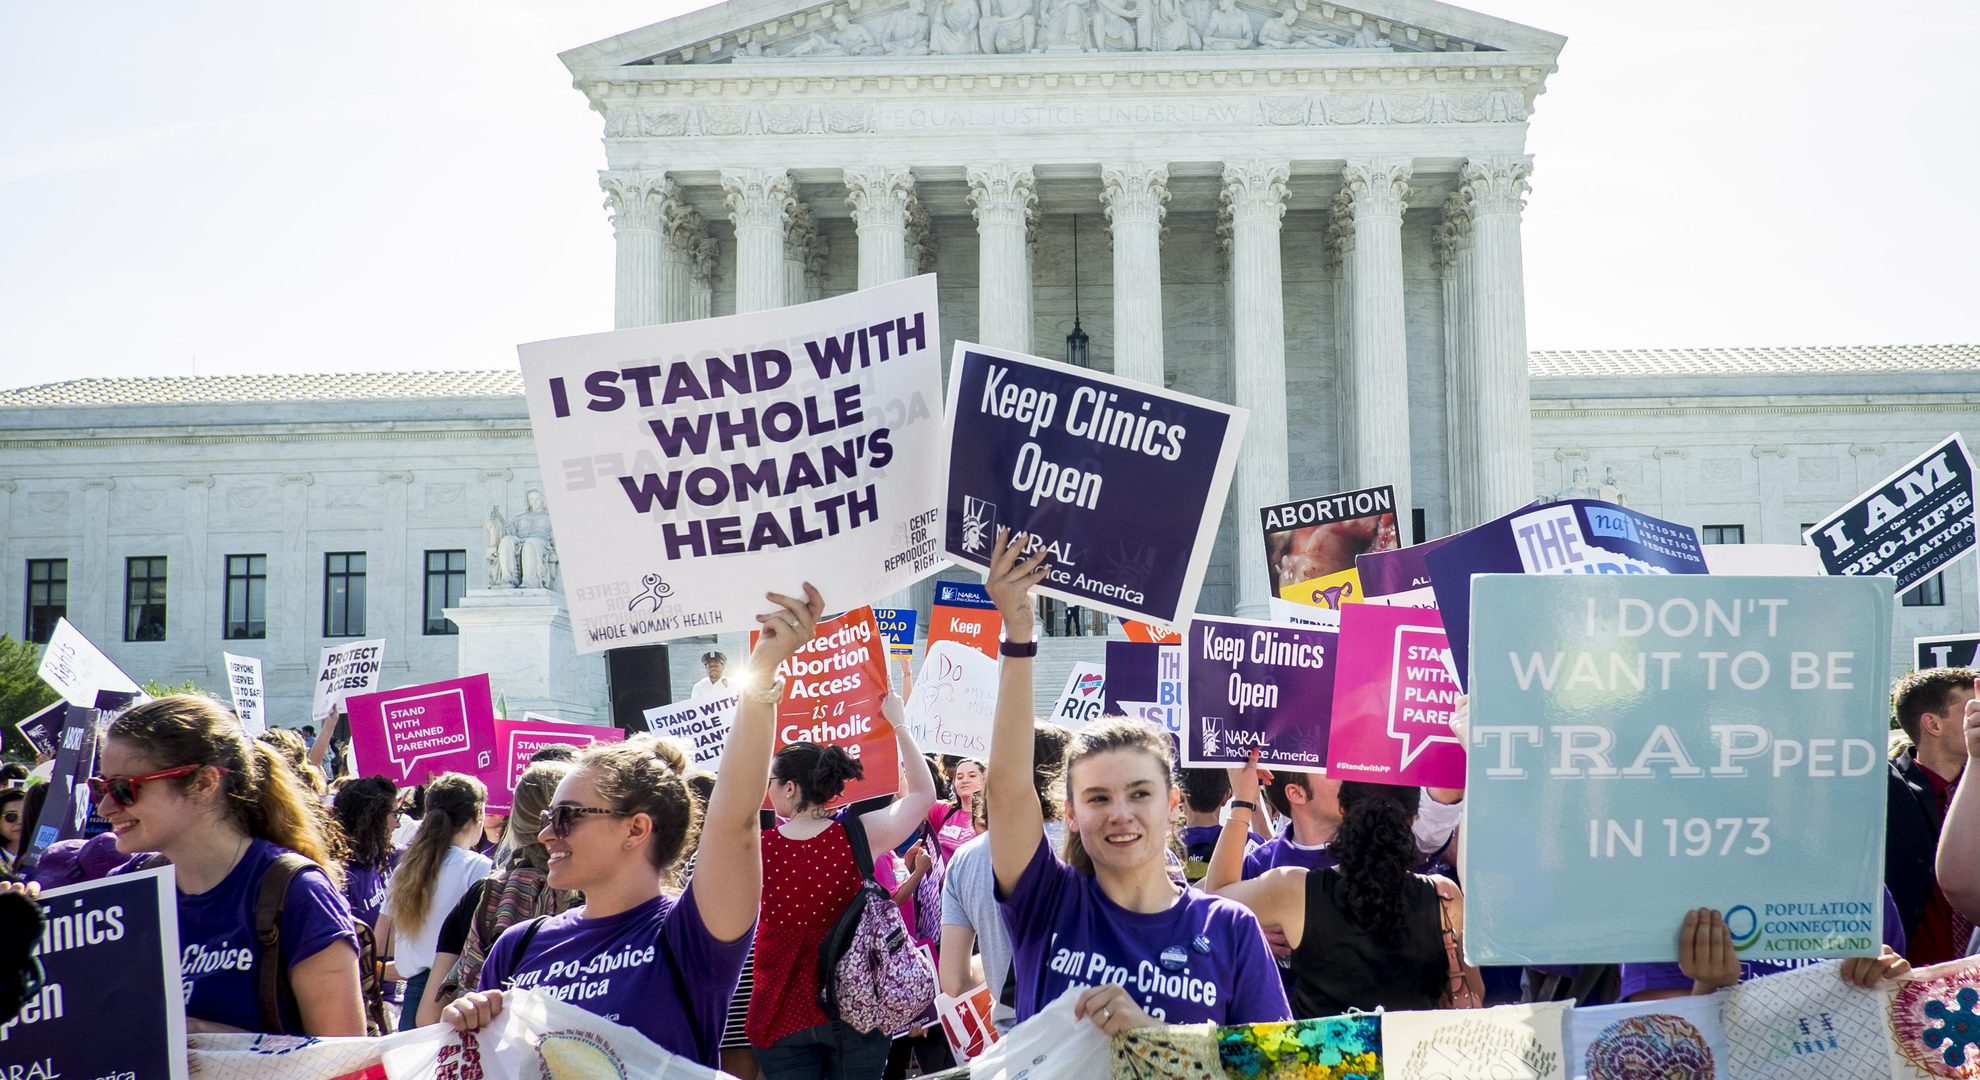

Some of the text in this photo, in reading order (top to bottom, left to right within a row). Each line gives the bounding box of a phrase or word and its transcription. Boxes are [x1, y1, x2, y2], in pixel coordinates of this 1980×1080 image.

[894, 103, 1240, 128] EQUAL JUSTICE UNDER LAW
[549, 377, 571, 418] I
[584, 349, 793, 413] STAND
[804, 311, 927, 381] WITH
[648, 384, 864, 459] WHOLE
[980, 364, 1058, 438] Keep
[1065, 385, 1187, 461] Clinics
[618, 428, 894, 514] WOMAN'S
[1011, 442, 1103, 511] Open
[1265, 489, 1391, 530] ABORTION
[1823, 451, 1958, 557] I AM
[662, 484, 879, 561] HEALTH
[911, 528, 927, 545] FOR
[1596, 512, 1631, 540] naf
[1634, 518, 1693, 541] NATIONAL
[1841, 490, 1972, 576] PRO-LIFE
[1890, 517, 1907, 531] the
[1518, 516, 1584, 573] THE
[1639, 529, 1696, 552] ABORTION
[1643, 540, 1701, 562] FEDERATION
[914, 553, 945, 573] RIGH
[1897, 534, 1975, 587] DENTSFORLIFE.O
[1073, 573, 1145, 605] America
[589, 611, 723, 642] WHOLE WOMAN'S HEALTH
[950, 617, 981, 637] Keep
[1585, 597, 1789, 638] I DON'T
[327, 647, 378, 667] PROTECT
[775, 646, 870, 677] Abortion
[1203, 626, 1325, 669] Keep Clinics
[1408, 646, 1441, 662] STA
[320, 661, 380, 681] ABORTION
[939, 653, 962, 681] Do
[1407, 667, 1452, 683] WITH
[1508, 651, 1854, 691] WANT TO BE
[326, 676, 368, 695] ACCESS
[790, 672, 862, 700] Access
[1228, 672, 1279, 713] Open
[391, 707, 425, 719] STAND
[650, 695, 739, 730] I STAND WITH
[812, 700, 845, 720] is a
[393, 719, 420, 730] WITH
[395, 726, 444, 741] PLANNED
[669, 716, 722, 738] WHOLE
[781, 714, 872, 745] Catholic
[1225, 730, 1270, 746] NARAL
[397, 734, 465, 753] PARENTHOOD
[1225, 747, 1319, 763] Pro-Choce America
[1589, 817, 1771, 858] IN 1973
[1764, 902, 1873, 916] POPULATION
[34, 899, 126, 957] inics
[1764, 920, 1873, 934] CONNECTION
[181, 941, 253, 972] Choice
[1764, 938, 1872, 951] ACTION FUND
[1050, 948, 1086, 977] am
[1086, 953, 1217, 1007] Pro-Choice
